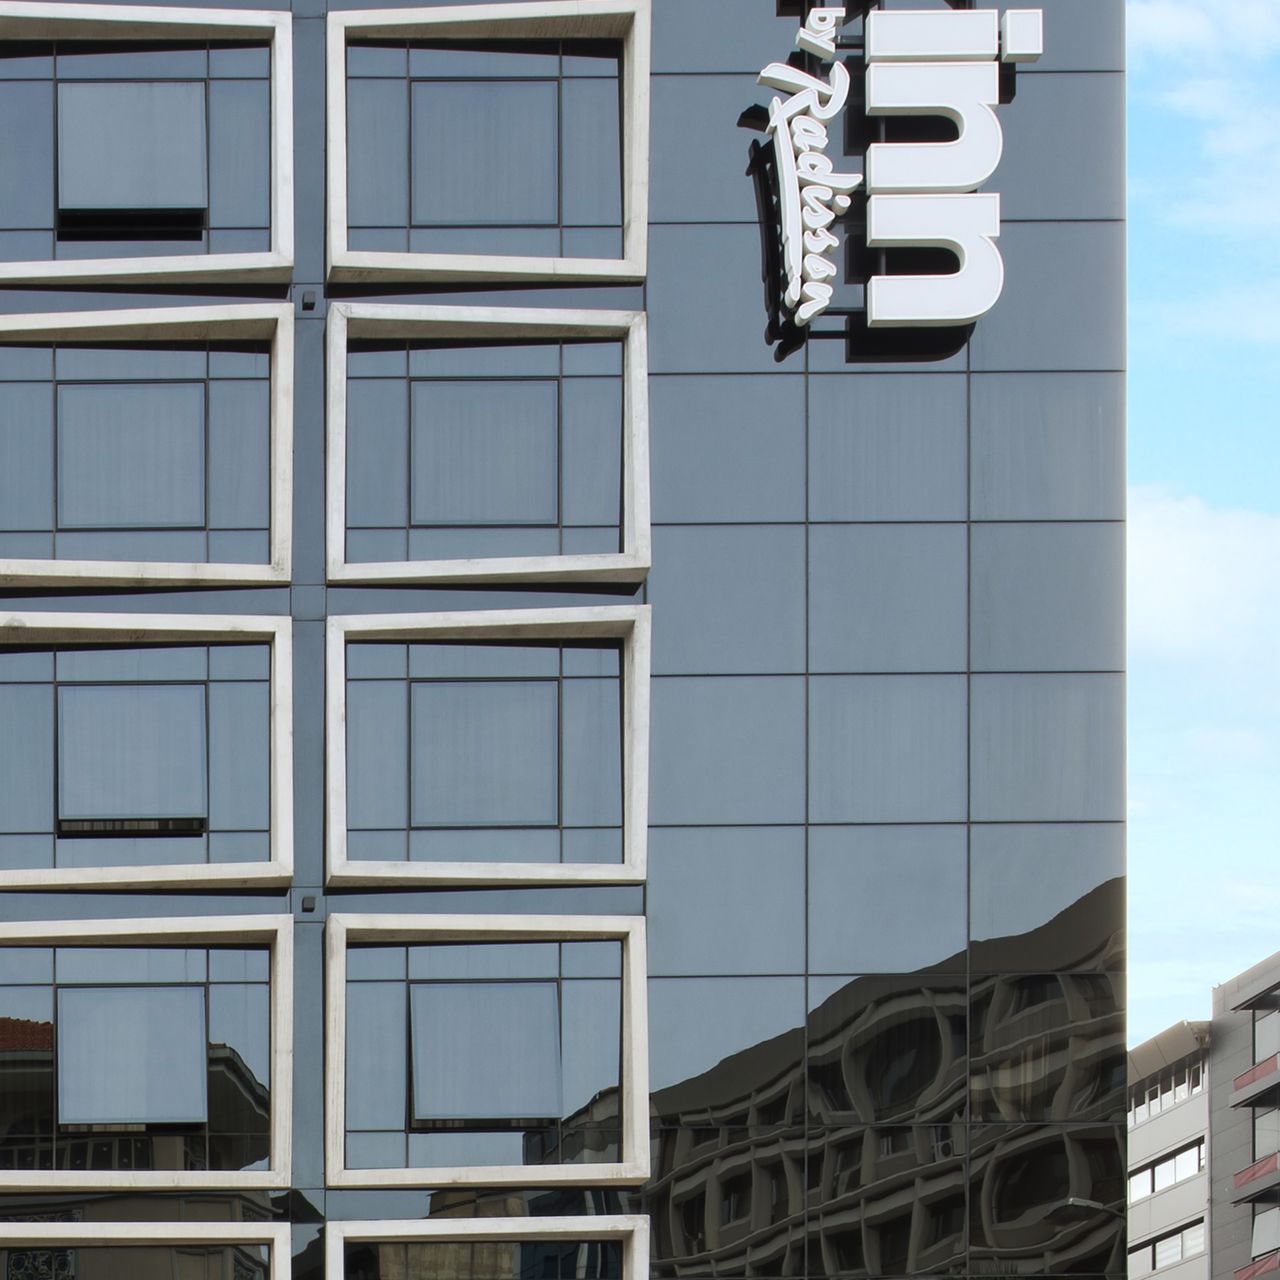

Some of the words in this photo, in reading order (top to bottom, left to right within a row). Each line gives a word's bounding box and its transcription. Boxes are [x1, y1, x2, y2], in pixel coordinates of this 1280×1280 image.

[795, 6, 847, 59] by
[756, 60, 863, 327] Radisson
[864, 8, 1044, 329] inn
